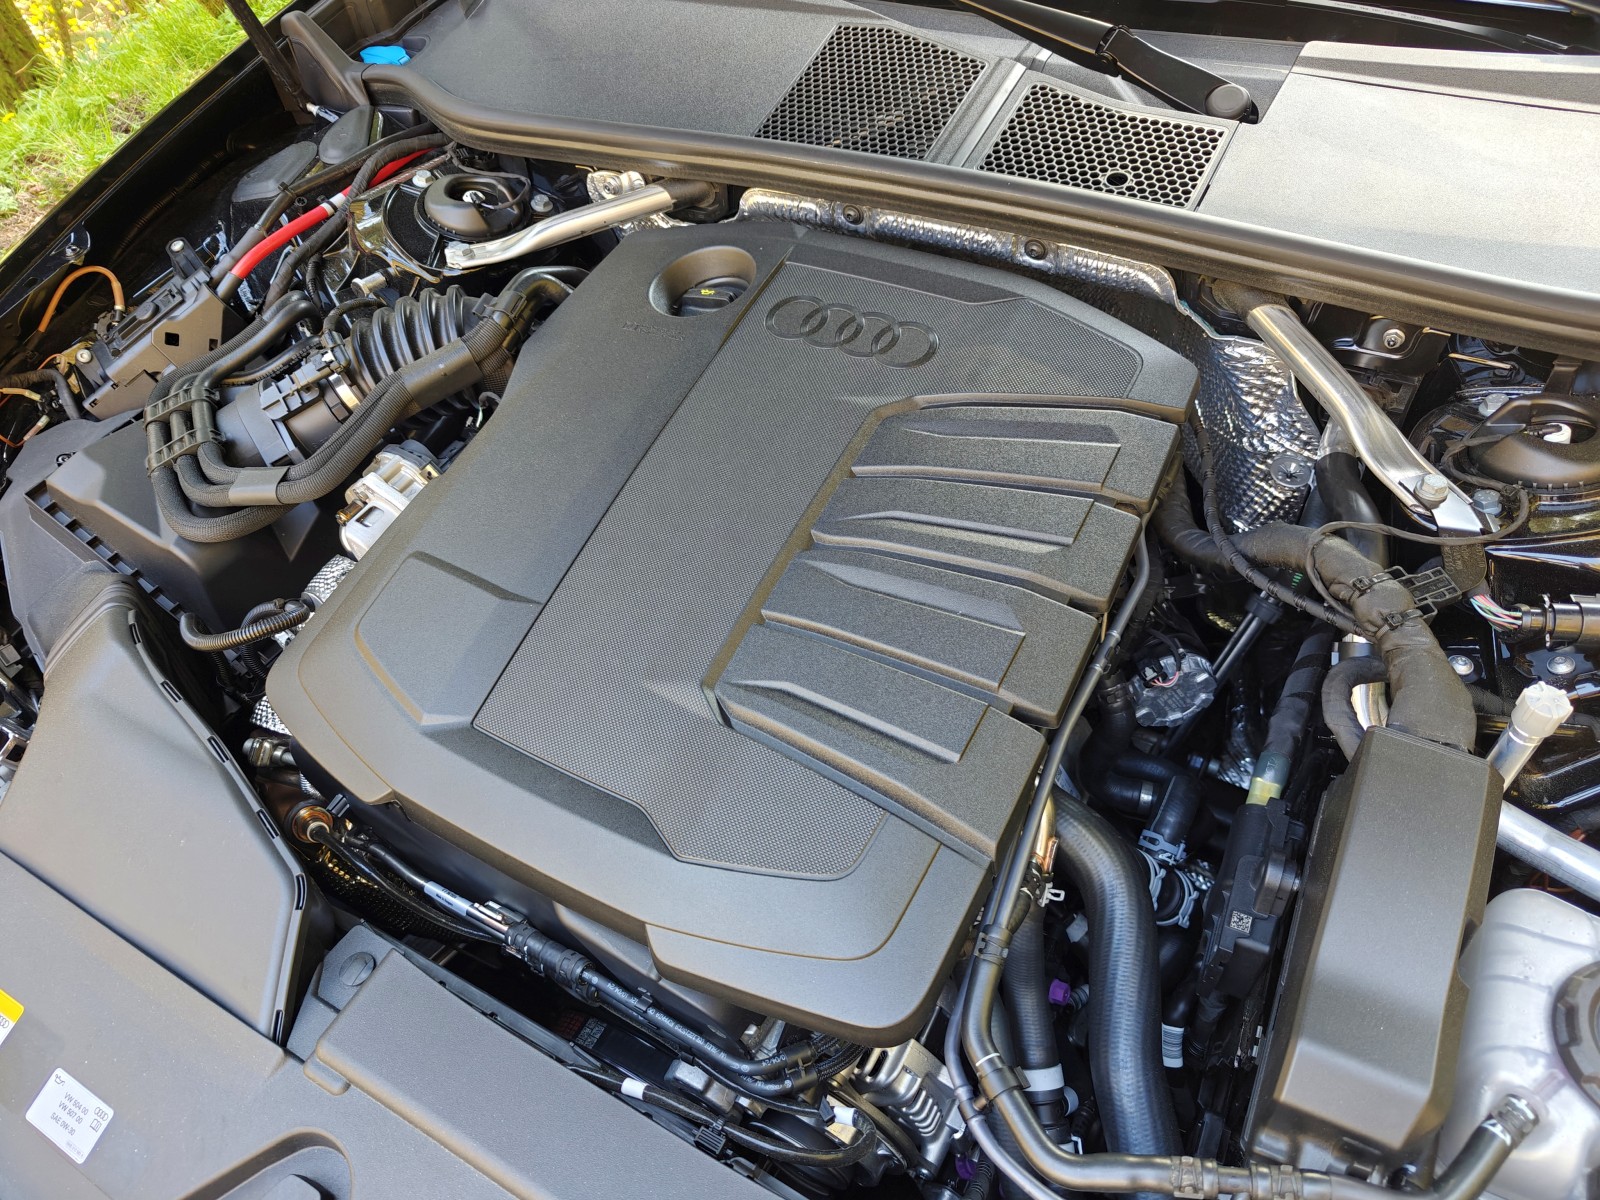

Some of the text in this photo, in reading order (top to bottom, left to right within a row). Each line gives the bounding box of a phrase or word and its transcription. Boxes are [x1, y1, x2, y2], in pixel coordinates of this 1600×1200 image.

[761, 1054, 786, 1067] 0/04/24
[58, 1100, 84, 1125] VW 507 00
[64, 1092, 89, 1116] VW 504 00
[50, 1112, 76, 1136] SAE 0W-30
